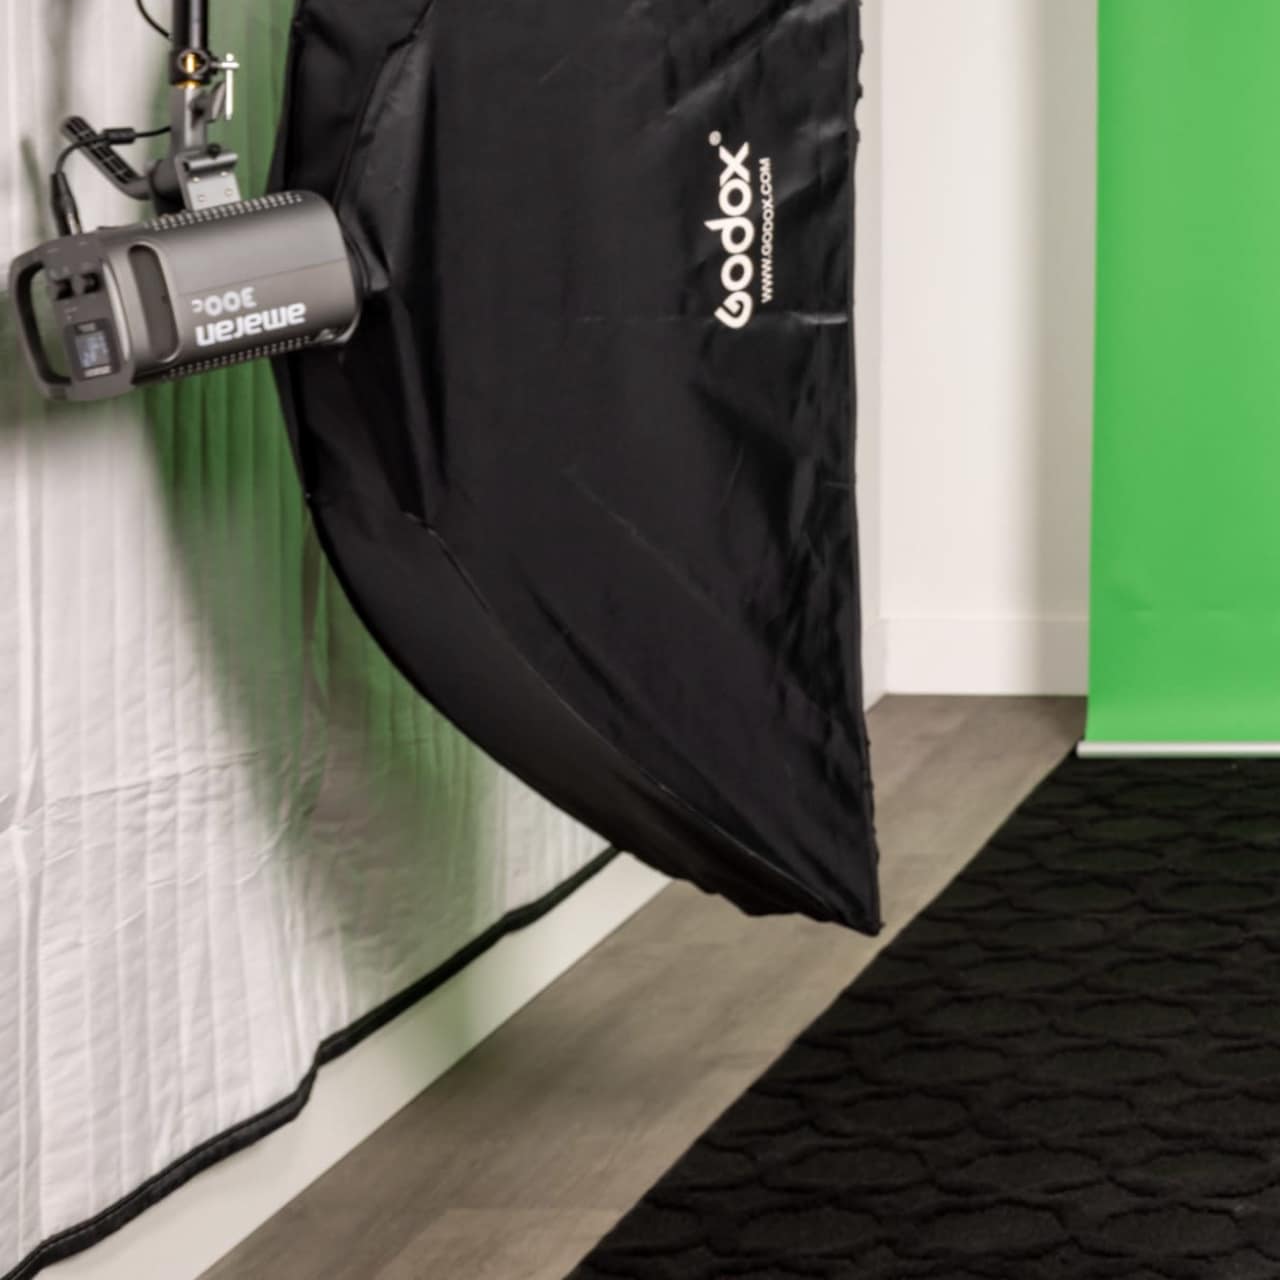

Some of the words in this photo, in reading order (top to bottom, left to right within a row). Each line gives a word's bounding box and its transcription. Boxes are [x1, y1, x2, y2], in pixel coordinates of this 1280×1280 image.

[704, 141, 754, 329] Godox
[759, 157, 775, 304] WWW.GODOX.COM
[192, 287, 256, 317] 300c
[195, 302, 306, 347] amaran
